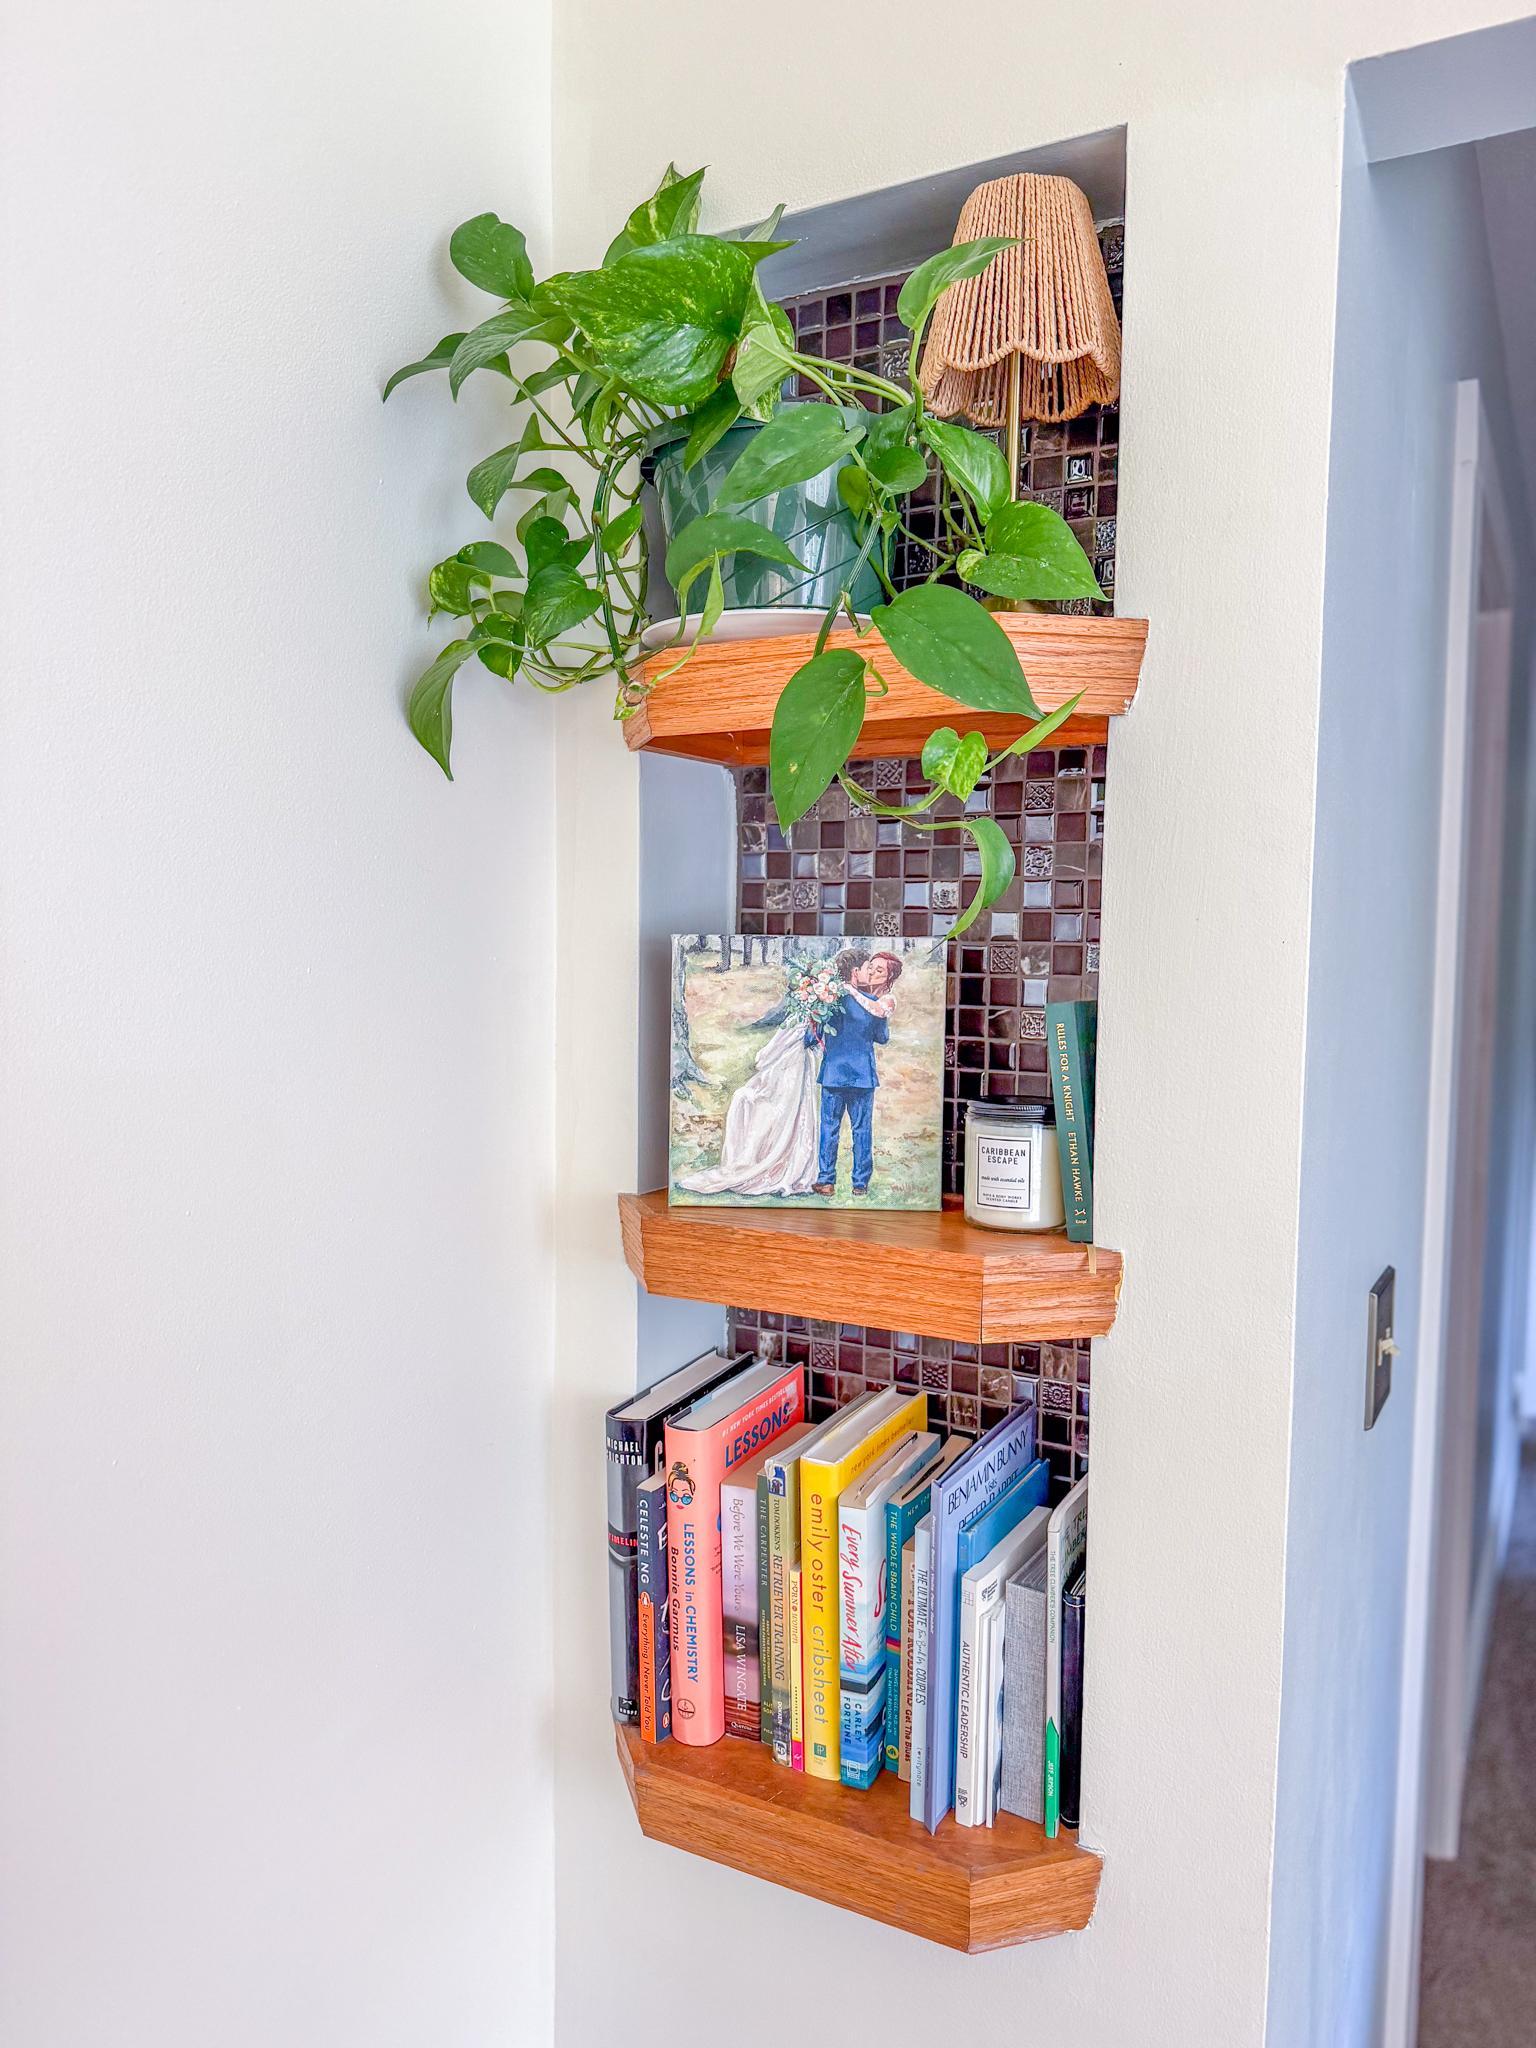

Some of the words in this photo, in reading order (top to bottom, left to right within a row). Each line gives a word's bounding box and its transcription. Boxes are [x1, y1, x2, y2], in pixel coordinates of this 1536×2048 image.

[1055, 1022, 1067, 1051] RULES
[1060, 1052, 1069, 1072] FOR
[1061, 1074, 1070, 1082] A
[1062, 1084, 1075, 1122] KNIGHT
[981, 1146, 1026, 1157] CARIBBEAN
[987, 1155, 1018, 1165] ESCAPE
[1067, 1132, 1080, 1165] ETHAN
[1071, 1167, 1084, 1202] HAWKE
[606, 1436, 640, 1453] MICHAEL
[726, 1401, 792, 1469] LESSONS
[606, 1450, 643, 1466] RICHTON
[948, 1455, 995, 1515] BENJAMIN
[997, 1425, 1029, 1472] BUNNY
[639, 1499, 649, 1557] CELESTE
[729, 1498, 745, 1532] Before
[759, 1499, 768, 1520] THE
[807, 1493, 831, 1553] emily
[890, 1511, 898, 1529] THE
[608, 1532, 639, 1547] TIMELIN
[684, 1523, 696, 1586] LESSONS
[733, 1534, 745, 1551] We
[759, 1524, 768, 1586] CARPENTER
[840, 1523, 862, 1572] Every
[640, 1562, 650, 1584] NG
[671, 1546, 680, 1594] Bonnie
[733, 1554, 745, 1578] Were
[917, 1568, 928, 1586] THE
[685, 1591, 696, 1602] in
[734, 1583, 745, 1612] Yours
[773, 1554, 784, 1620] RETRIEVER
[811, 1559, 827, 1613] oster
[842, 1570, 863, 1637] Summer
[672, 1598, 680, 1652] Garmus
[890, 1602, 898, 1631] CHILD
[917, 1586, 928, 1627] ULTIMATE
[641, 1613, 650, 1659] Everything
[685, 1605, 699, 1684] CHEMISTRY
[735, 1624, 746, 1651] LISA
[774, 1622, 785, 1681] TRAINING
[842, 1632, 865, 1671] After
[736, 1652, 747, 1712] WINGATE
[812, 1625, 832, 1724] cribsheet
[915, 1667, 926, 1706] COUPLES
[960, 1640, 971, 1698] AUTHENTIC
[843, 1696, 852, 1745] FORTUNE
[854, 1703, 862, 1743] CARLEY
[904, 1726, 912, 1740] The
[959, 1699, 969, 1759] LEADERSHIP
[904, 1741, 912, 1762] Blues
